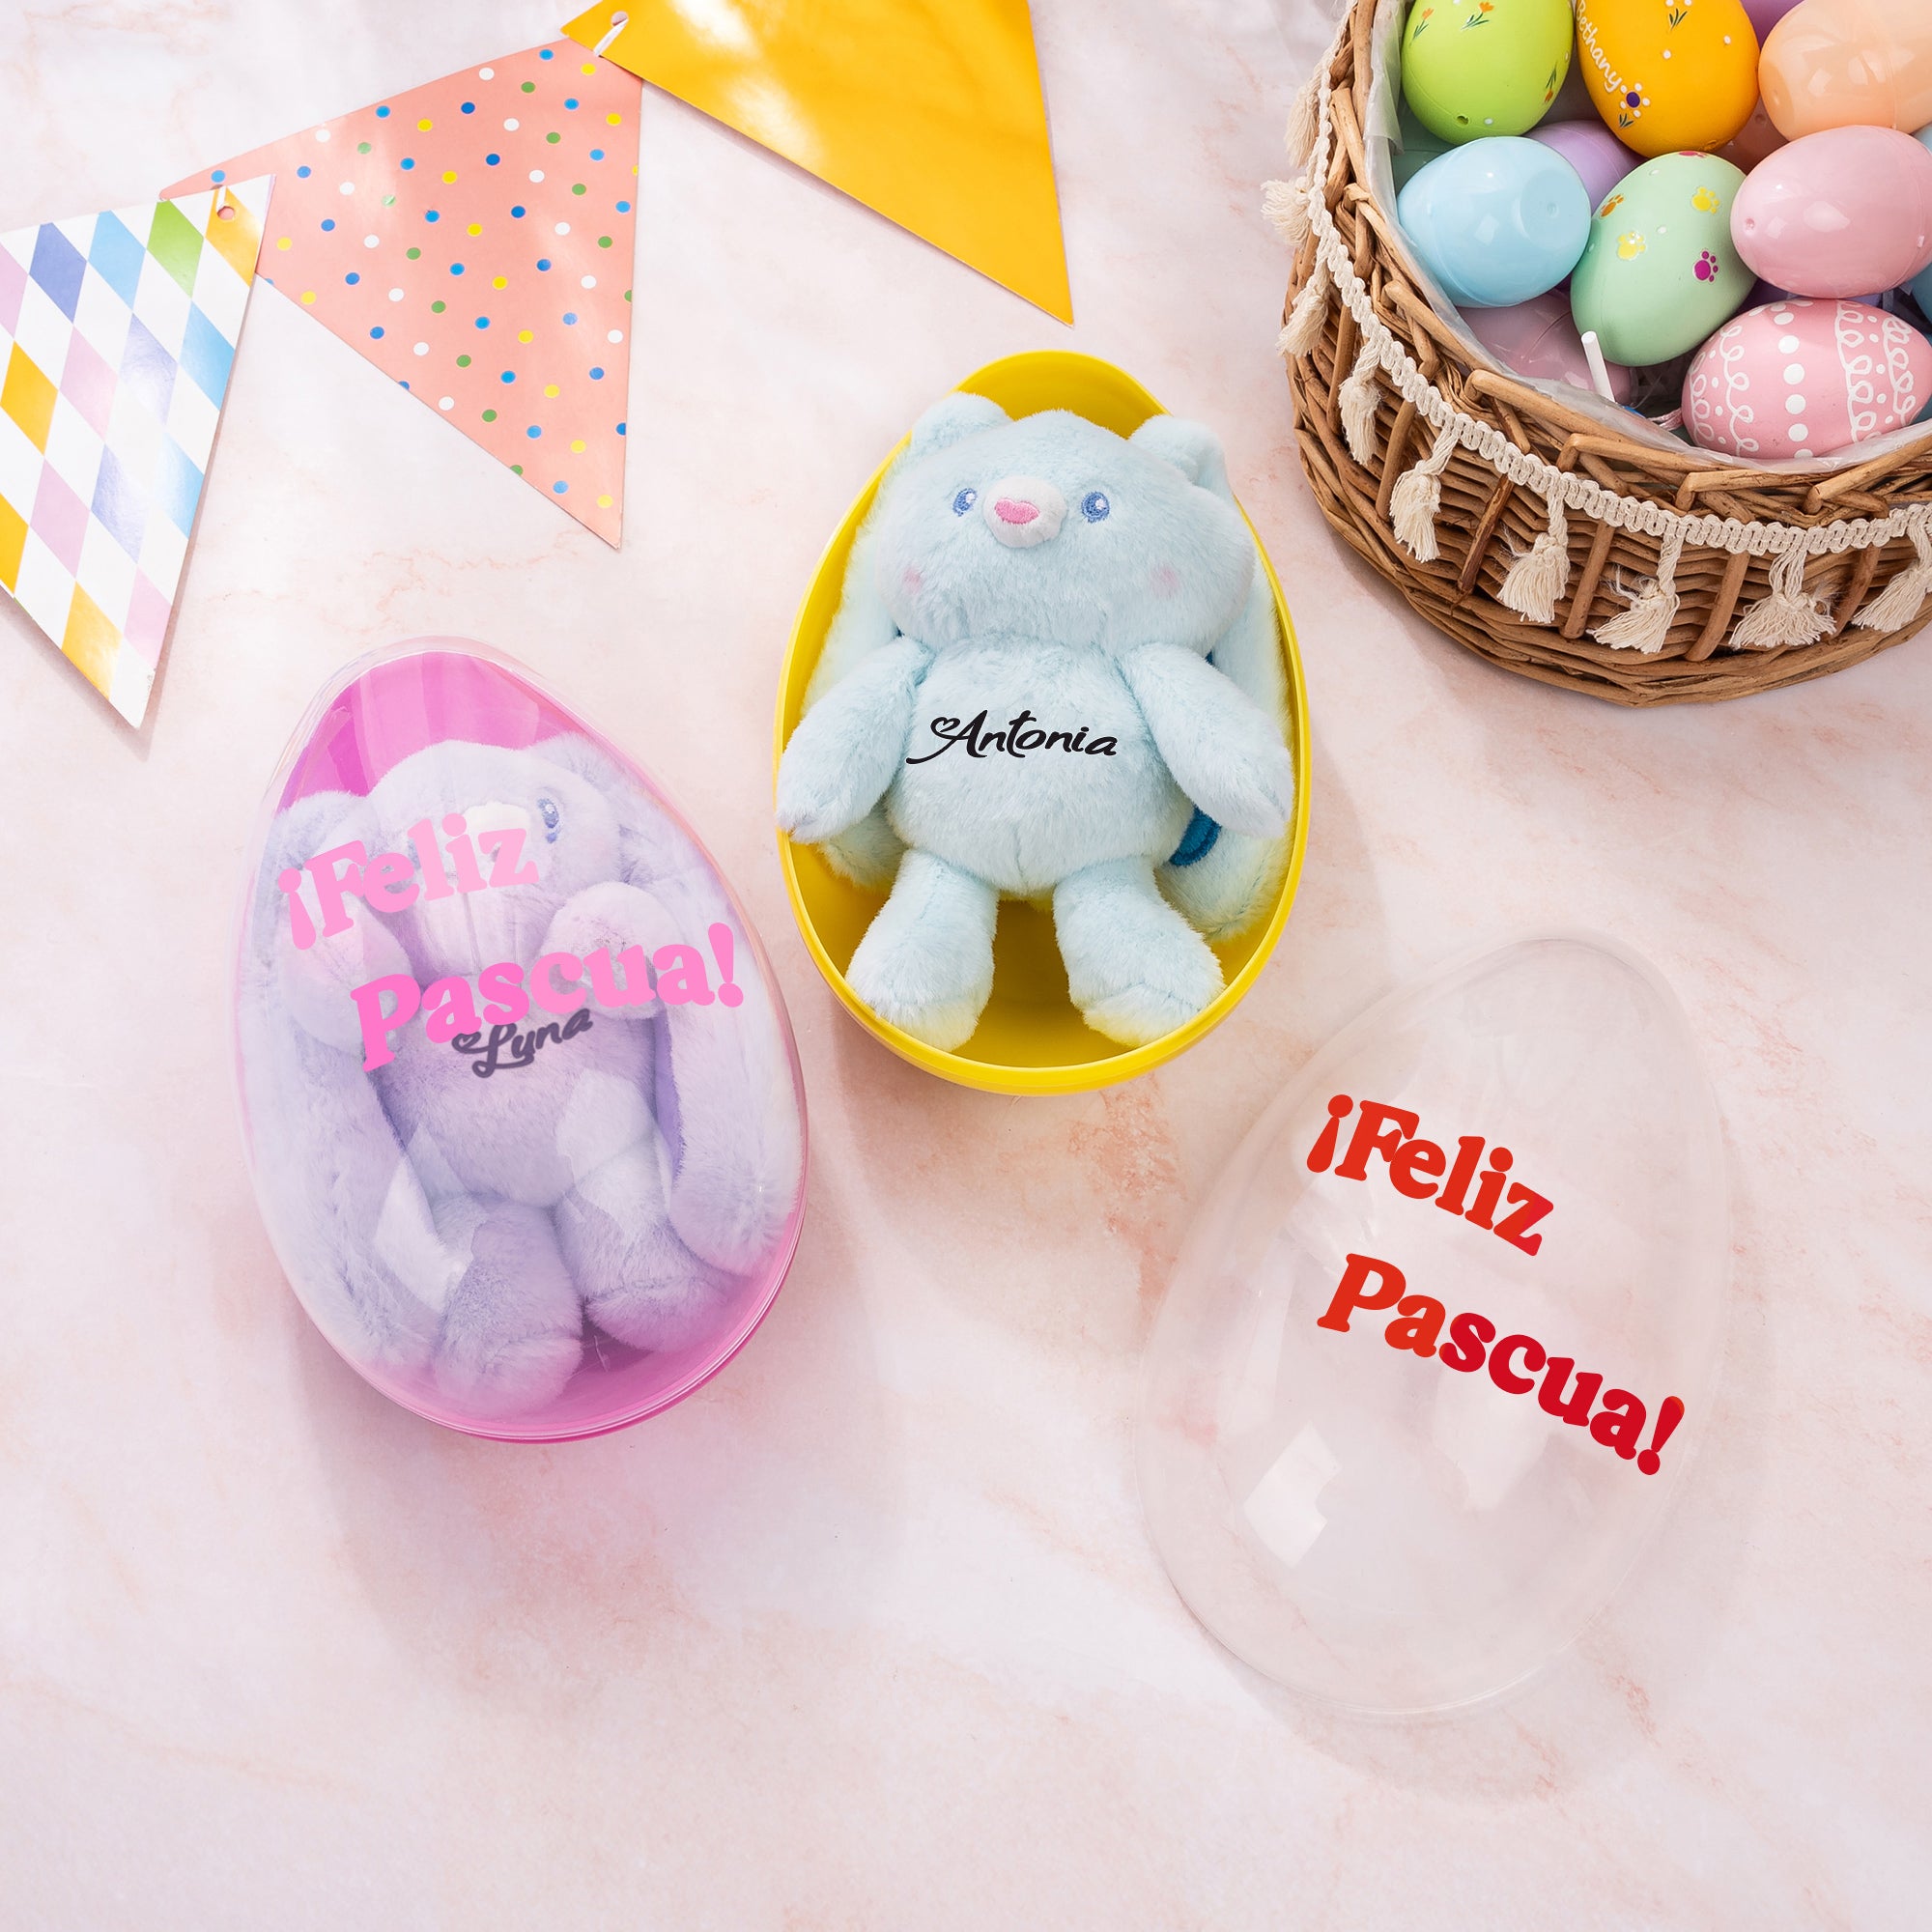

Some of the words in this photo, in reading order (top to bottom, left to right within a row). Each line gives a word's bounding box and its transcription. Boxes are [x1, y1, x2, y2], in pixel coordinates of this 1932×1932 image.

[1577, 0, 1622, 93] Bethany
[905, 710, 1118, 764] Antonia
[278, 812, 539, 950] ¡Feliz
[350, 923, 744, 1072] Pascua!
[1307, 1094, 1554, 1256] ¡Feliz
[1317, 1253, 1685, 1475] Pascua!
